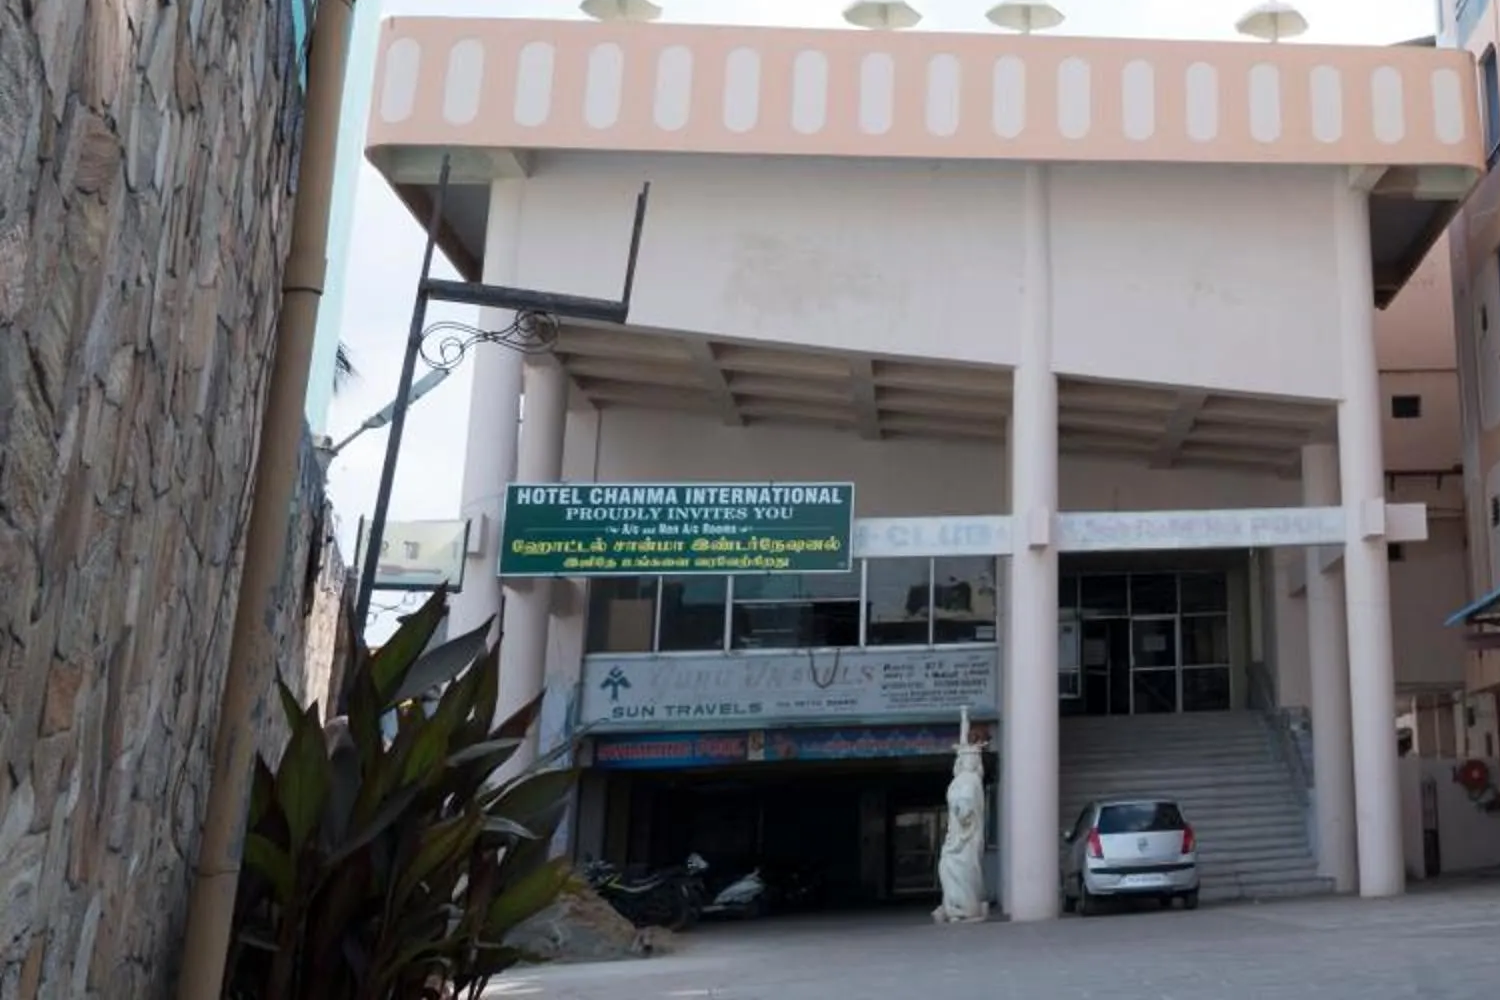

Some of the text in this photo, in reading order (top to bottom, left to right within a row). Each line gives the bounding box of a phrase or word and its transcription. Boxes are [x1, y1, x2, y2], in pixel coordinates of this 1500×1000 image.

[517, 487, 843, 505] HOTEL CHANMA INTERNATIONAL
[566, 506, 794, 521] PROUDLY INVITES YOU
[612, 705, 655, 718] SUN
[665, 702, 763, 716] TRAVELS
